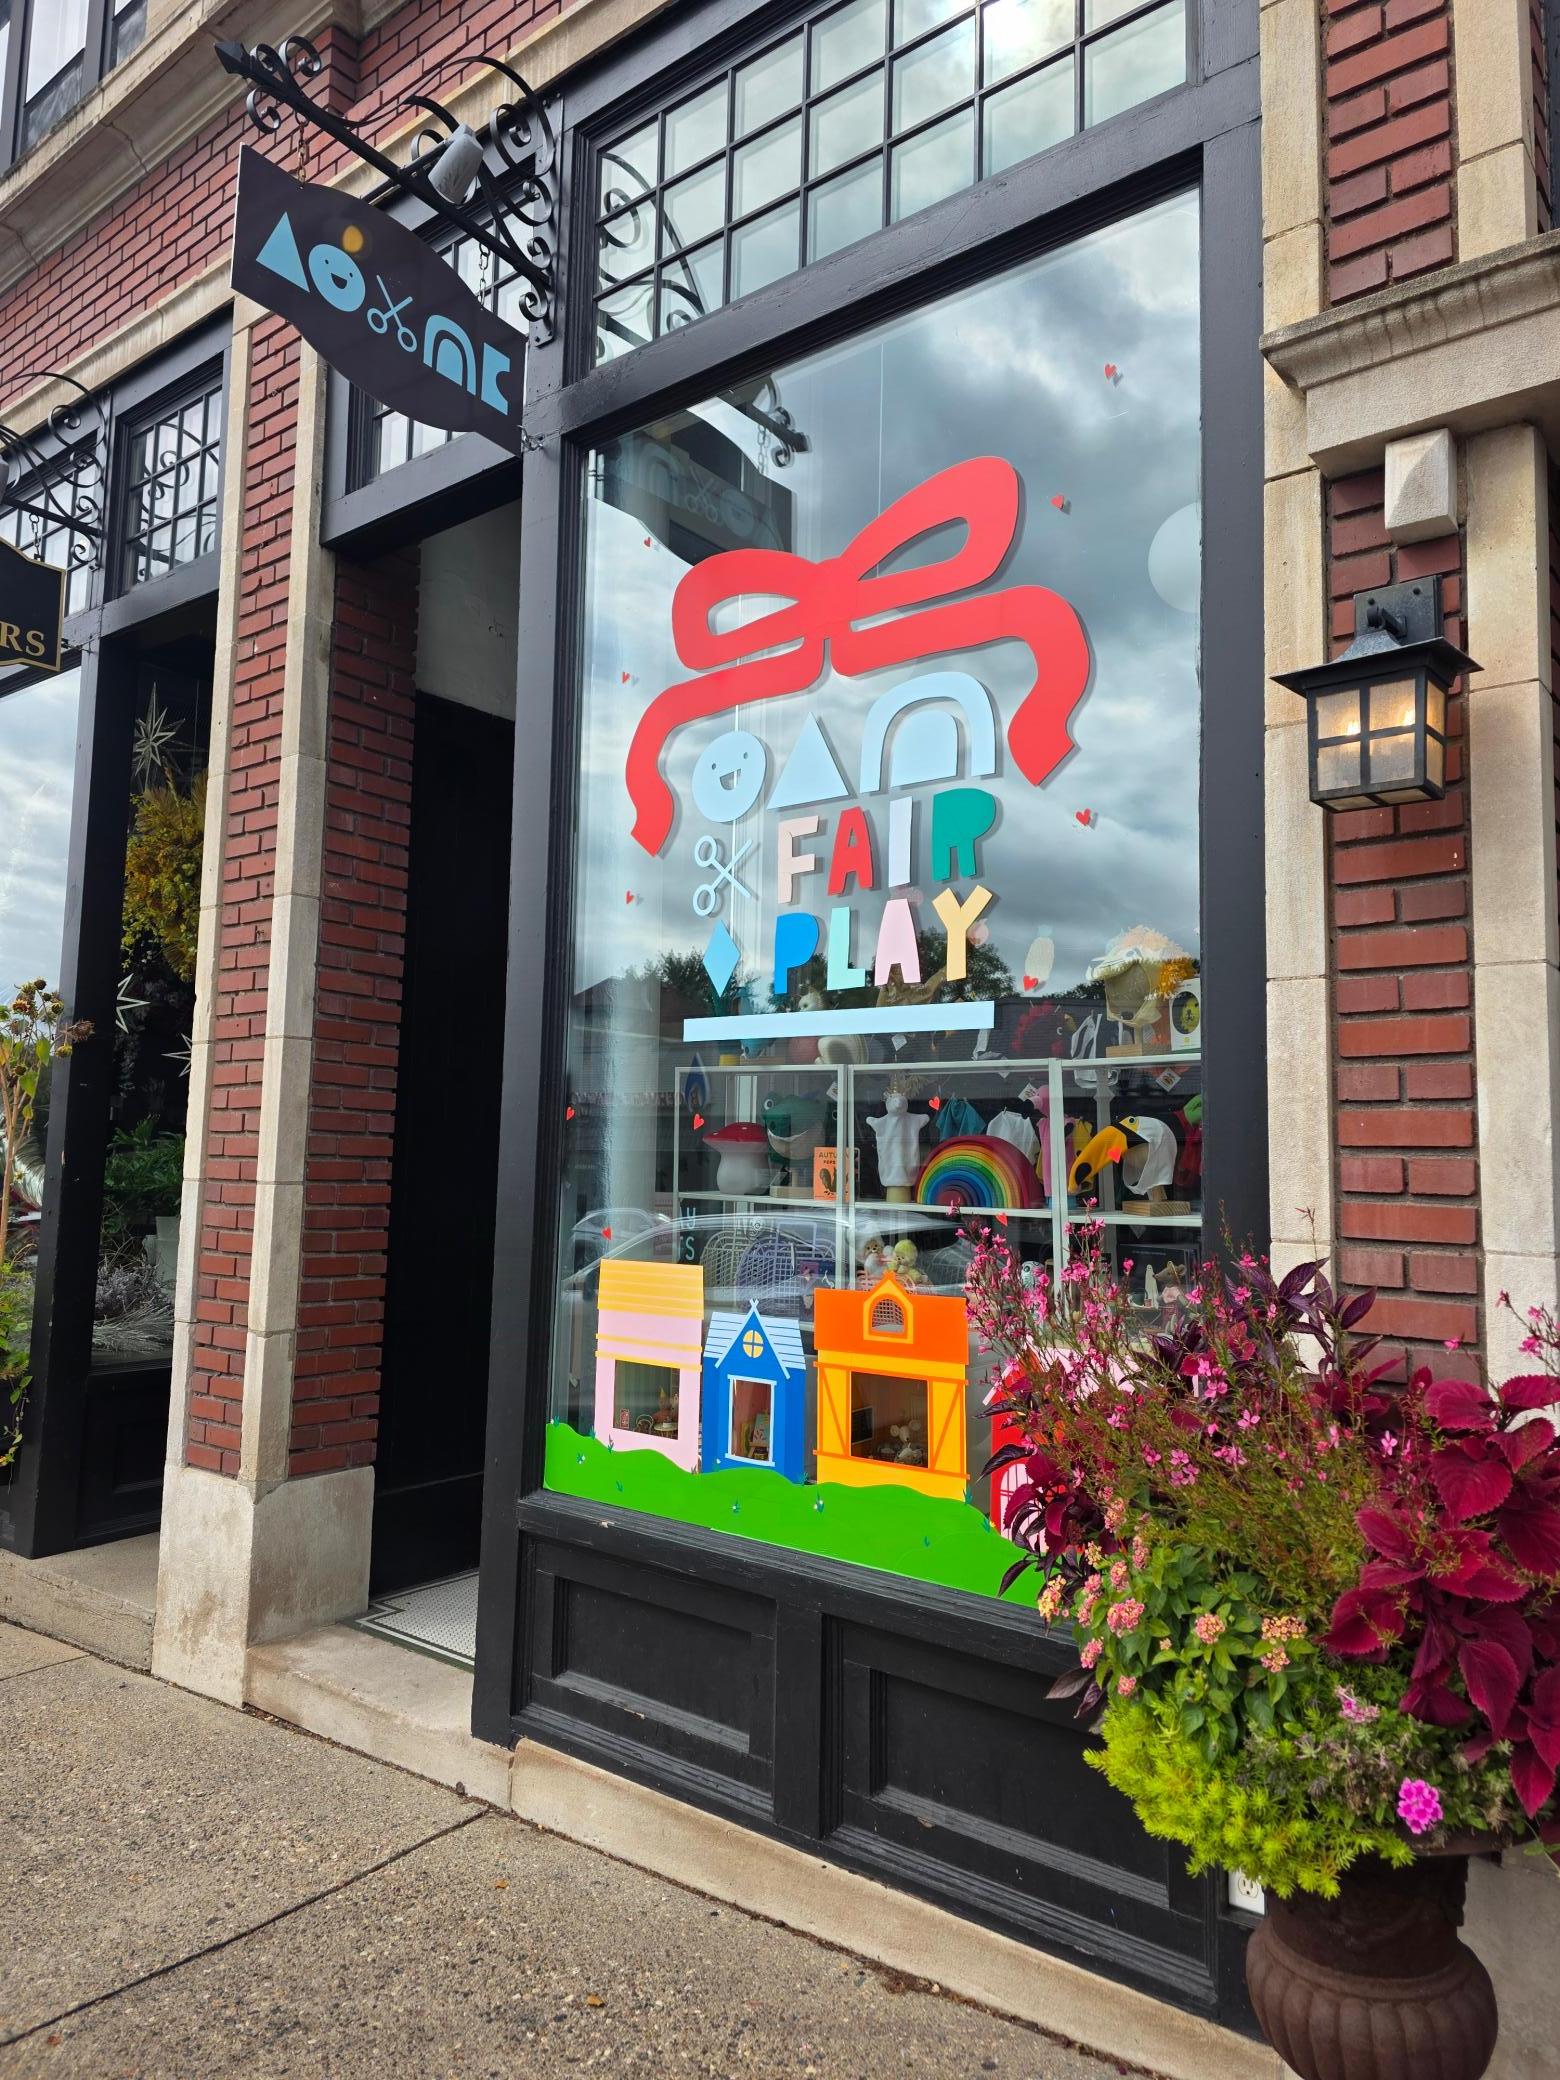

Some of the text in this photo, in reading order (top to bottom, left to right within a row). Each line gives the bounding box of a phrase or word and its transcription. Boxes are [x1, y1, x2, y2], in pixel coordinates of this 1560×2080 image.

[777, 788, 996, 904] FAIR
[774, 885, 993, 994] PLAY
[819, 1151, 848, 1159] AUTU
